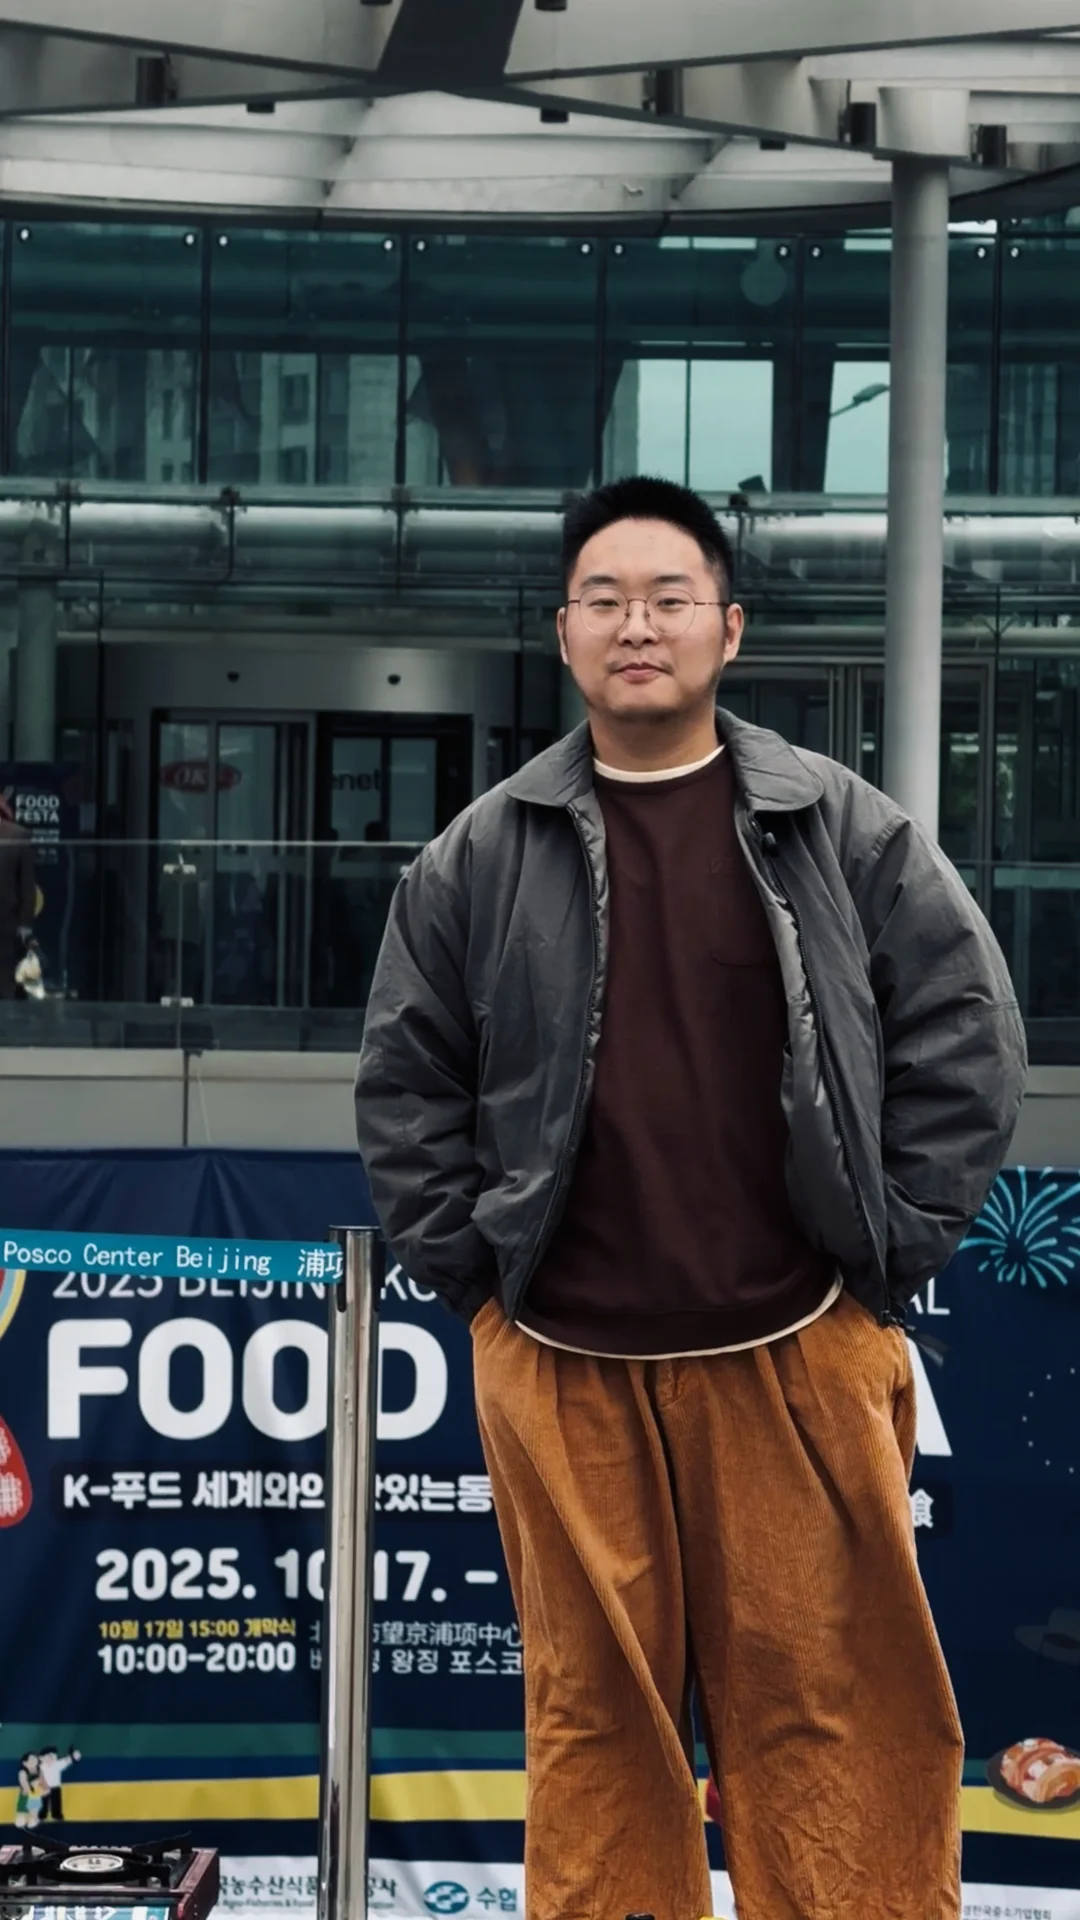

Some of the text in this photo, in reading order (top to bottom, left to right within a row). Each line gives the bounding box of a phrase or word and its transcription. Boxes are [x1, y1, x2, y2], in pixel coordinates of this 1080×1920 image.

[15, 794, 60, 809] FOOD
[3, 1241, 272, 1276] Posco Center Beijing
[48, 1318, 448, 1441] FOOD
[63, 1471, 183, 1509] K-푸드
[95, 1548, 257, 1600] 2025.
[144, 1618, 184, 1639] 17일
[188, 1618, 240, 1638] 15:00
[97, 1641, 297, 1675] 10:00-20:00
[391, 1649, 439, 1674] 왕징
[475, 1886, 518, 1912] 수협
